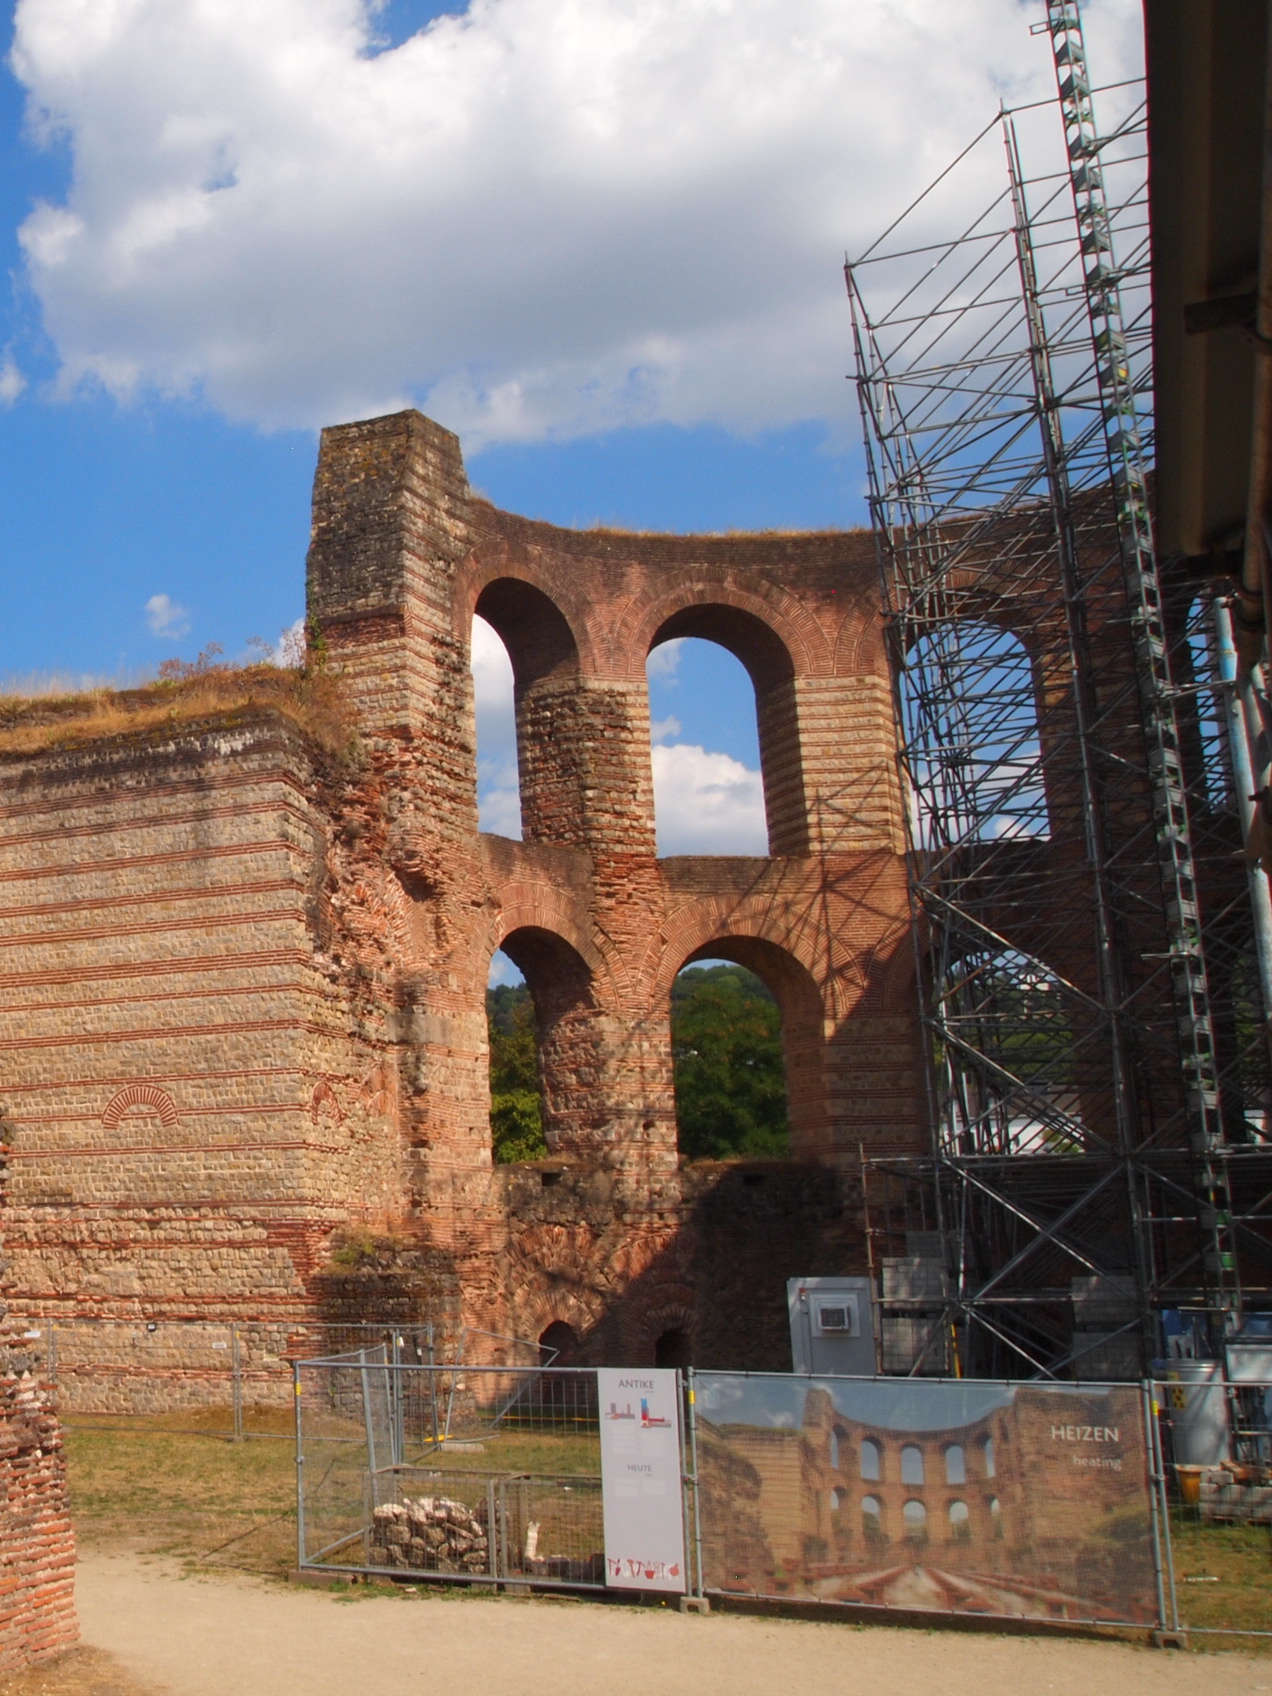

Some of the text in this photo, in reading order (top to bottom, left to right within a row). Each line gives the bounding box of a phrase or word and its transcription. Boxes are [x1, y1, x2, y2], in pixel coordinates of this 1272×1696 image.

[618, 1379, 654, 1389] ANTIKE
[1051, 1425, 1119, 1442] HEIZEN
[627, 1464, 652, 1472] HEUTE
[1073, 1455, 1122, 1471] heating
